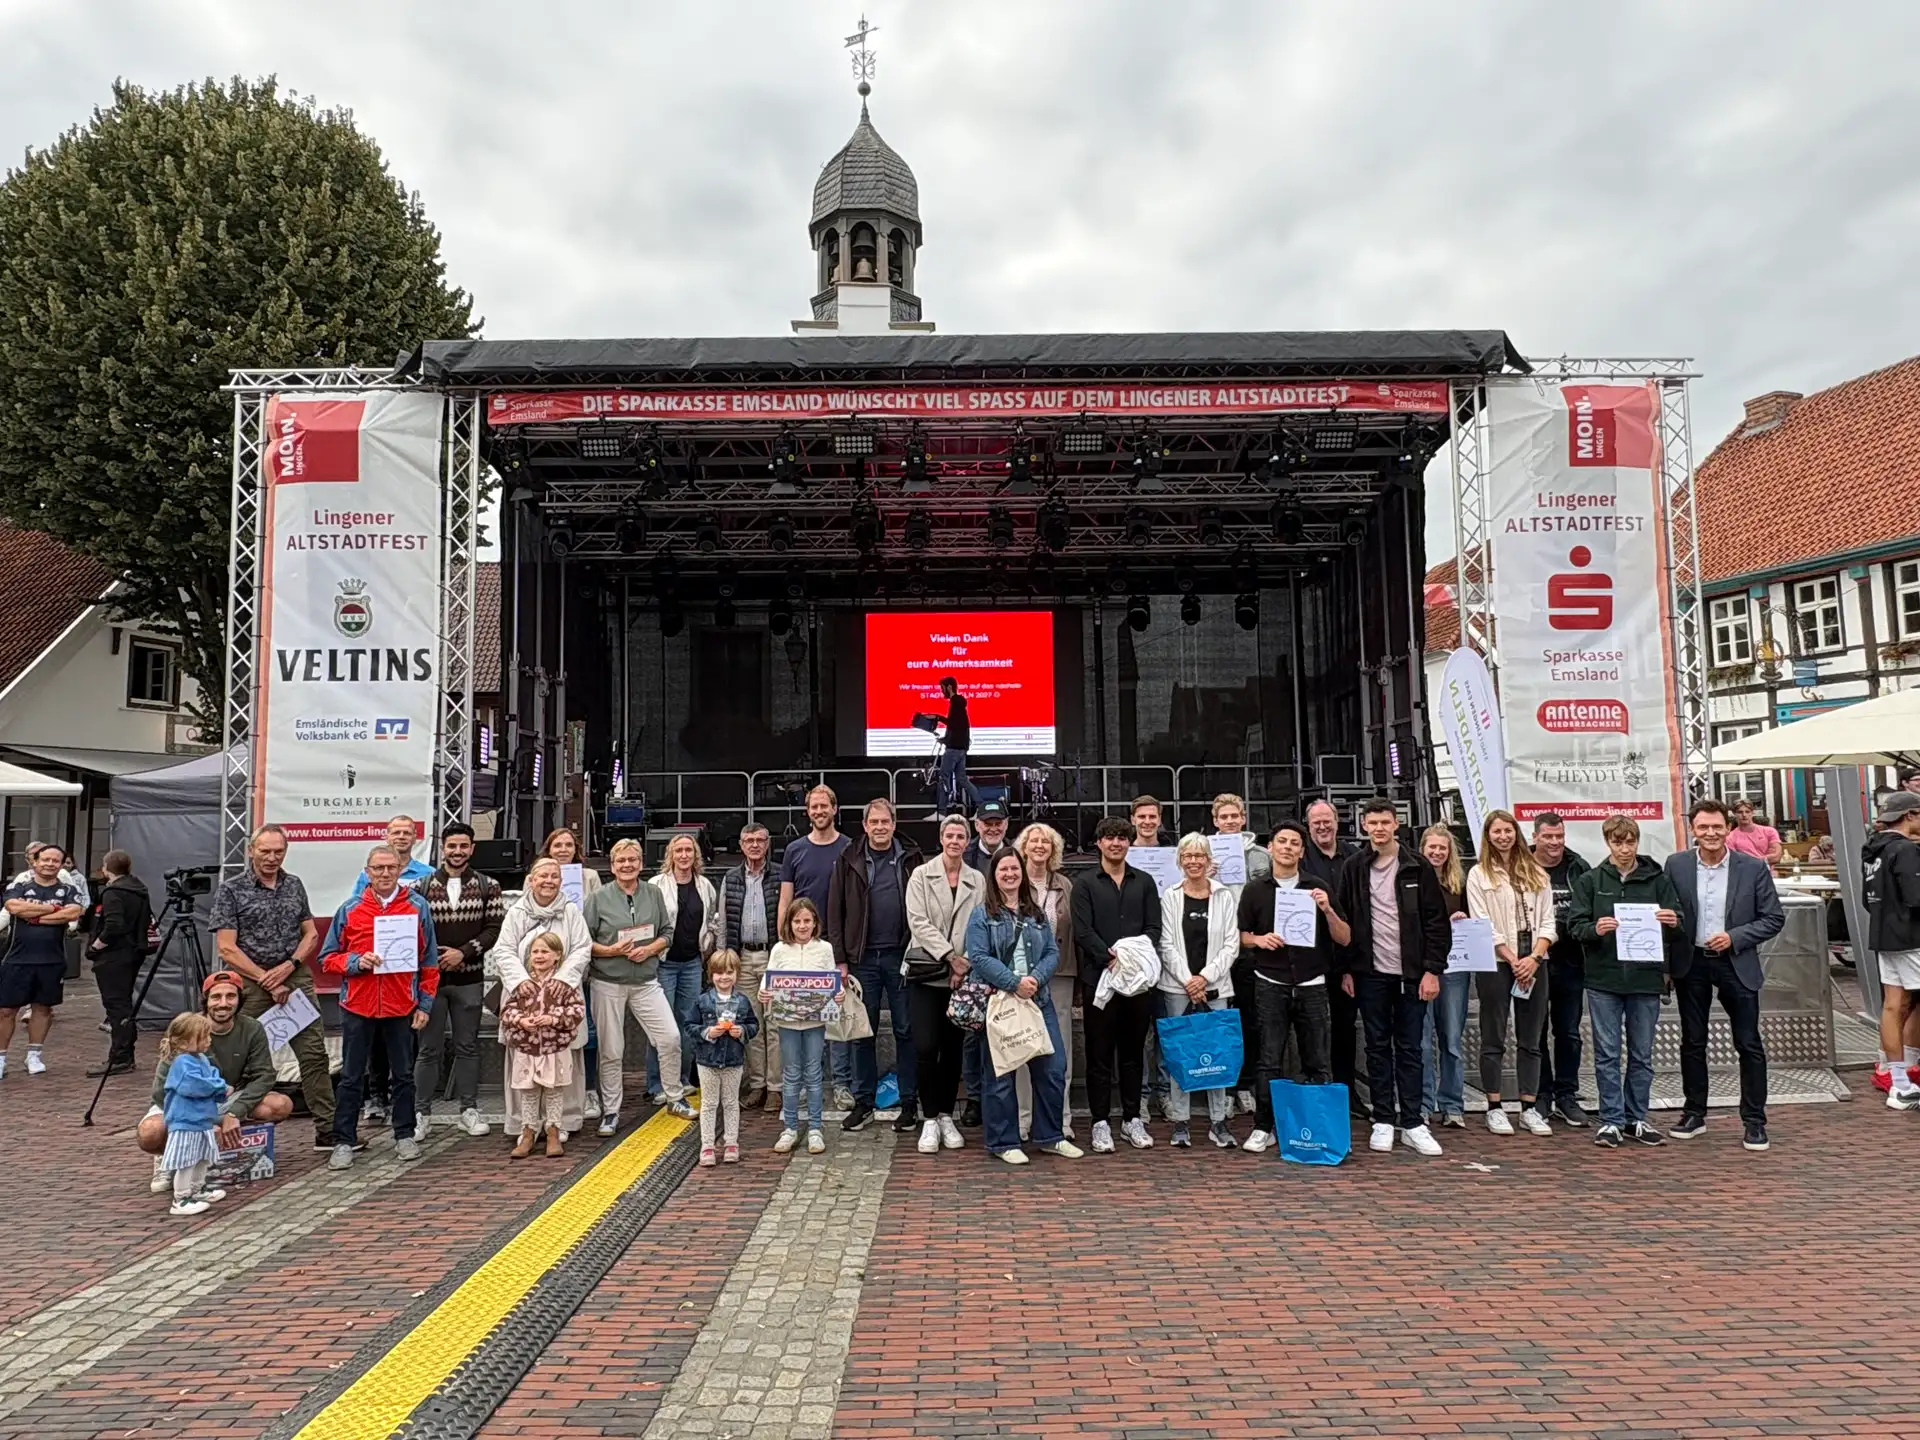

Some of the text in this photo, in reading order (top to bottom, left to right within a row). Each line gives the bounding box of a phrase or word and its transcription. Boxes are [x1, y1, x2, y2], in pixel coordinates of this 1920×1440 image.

[583, 386, 1350, 413] DIE SPARKASSE EMSLAND WÜNSCHT VIEL SPASS AUF DEM LINGENER ALTSTADTFEST
[1392, 388, 1437, 399] Sparkasse
[510, 399, 554, 411] Sparkasse
[1394, 399, 1430, 410] Emsland
[510, 409, 547, 421] Emsland
[1596, 427, 1604, 459] LINGEN
[296, 444, 304, 475] LINGEN
[1537, 492, 1617, 511] Lingener
[314, 509, 395, 529] Lingener
[1505, 516, 1644, 533] ALTSTADTFEST
[286, 534, 428, 551] ALTSTADTFEST
[930, 633, 989, 643] Vielen Dank
[952, 646, 967, 655] für
[907, 658, 1013, 669] eure Aufmerksamkeit
[1542, 649, 1624, 666] Sparkasse
[276, 648, 432, 682] VELTINS
[1550, 667, 1619, 681] Emsland
[295, 718, 368, 729] Emsländische
[1546, 720, 1622, 728] NIEDERSACHSEN
[295, 731, 368, 741] Volksbank eG
[1557, 769, 1618, 782] HEYDT
[773, 978, 834, 989] MONOPOLY
